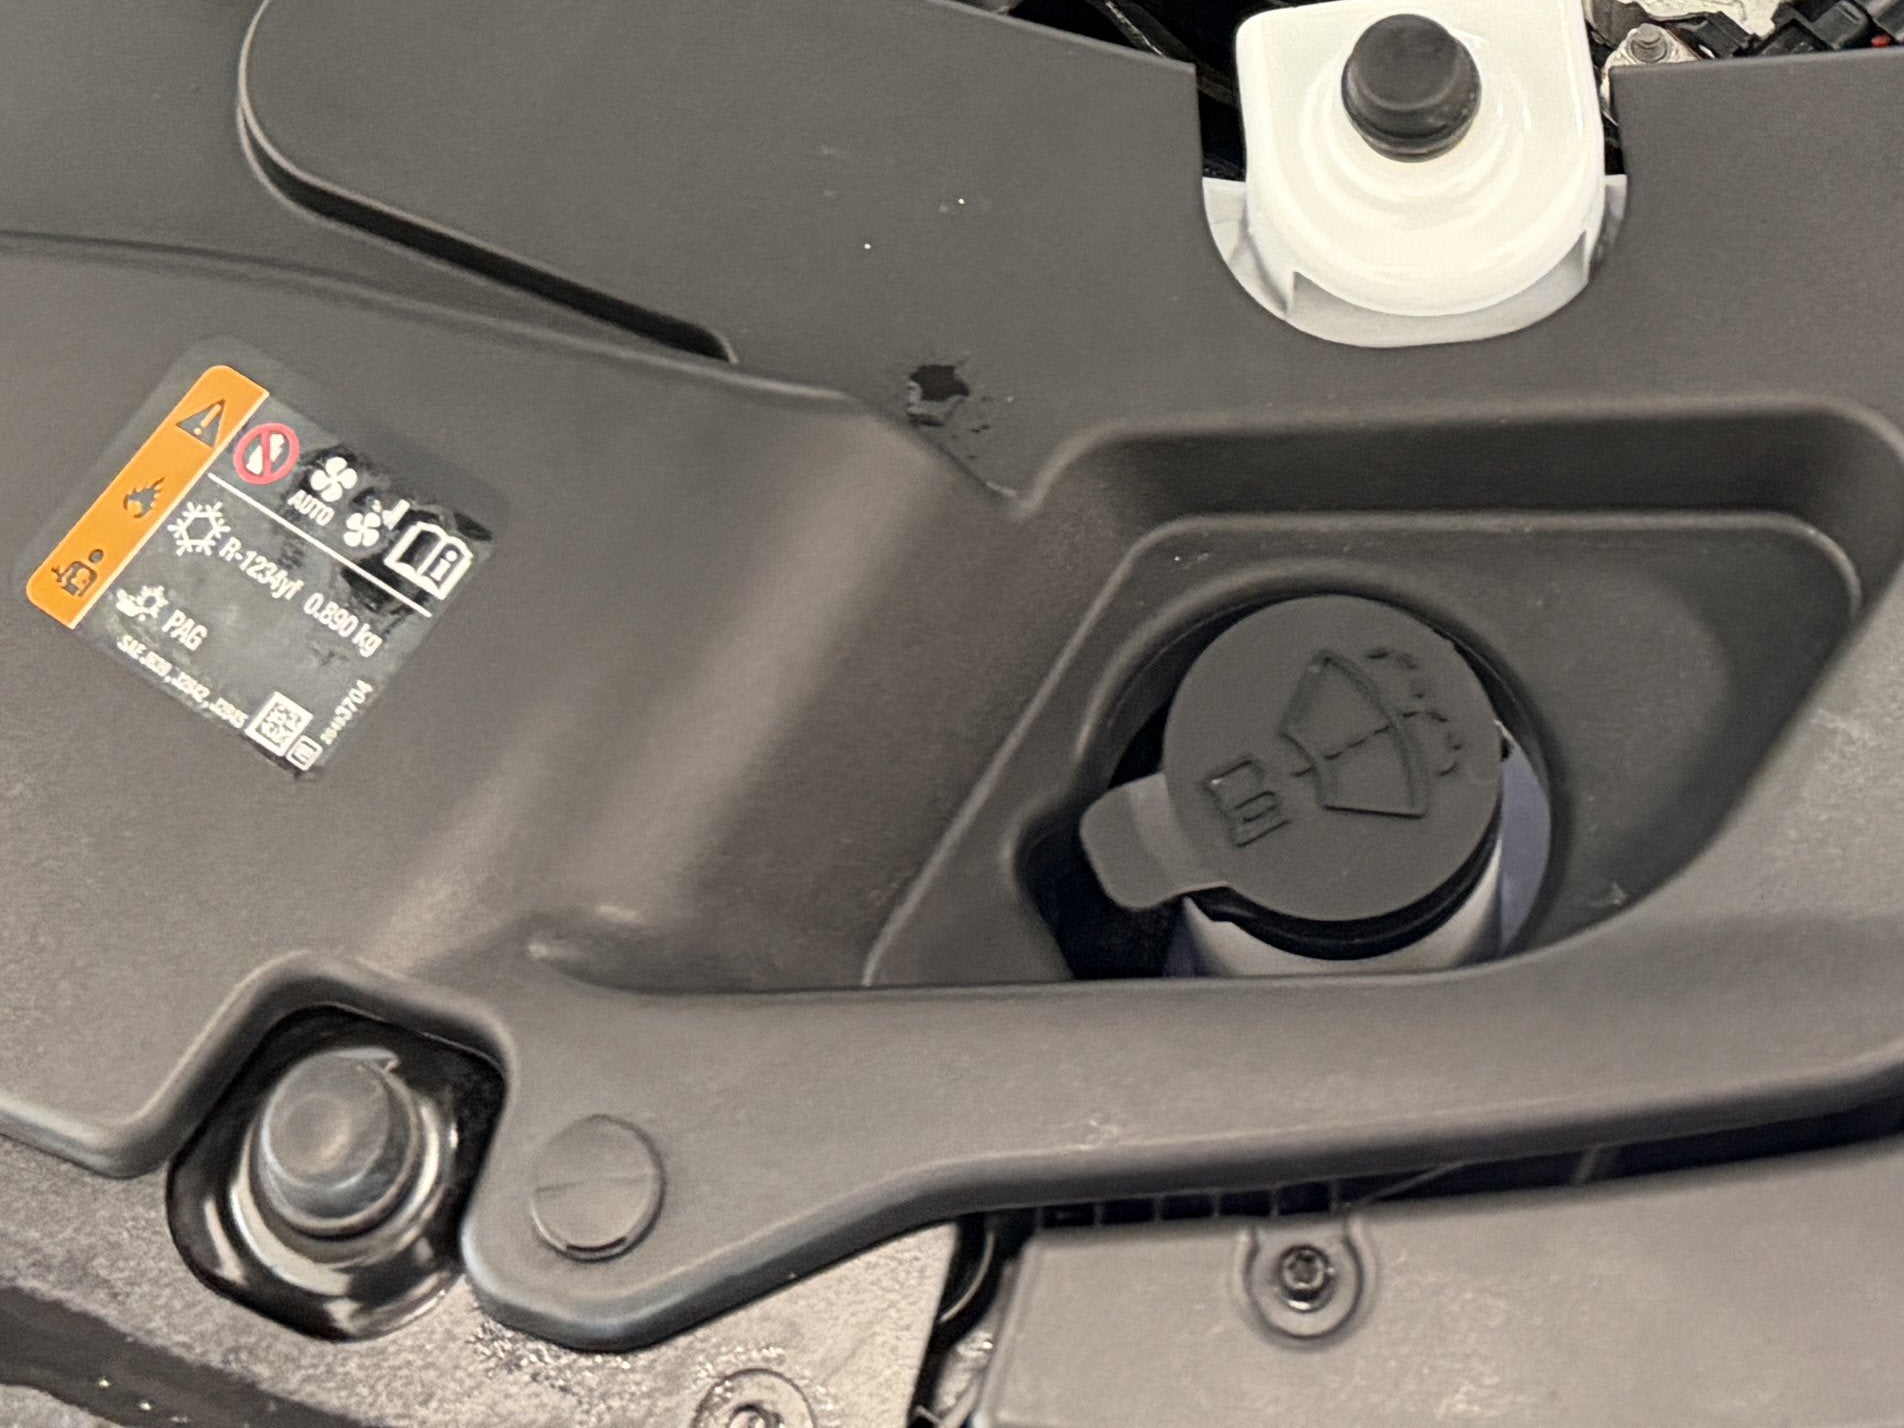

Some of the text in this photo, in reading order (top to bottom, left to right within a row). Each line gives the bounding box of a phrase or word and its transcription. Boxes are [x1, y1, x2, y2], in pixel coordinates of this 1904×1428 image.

[287, 490, 333, 525] AUTO
[219, 537, 381, 657] R-1234yf 0.890 kg
[117, 634, 145, 658] SAE
[161, 610, 206, 649] PAG
